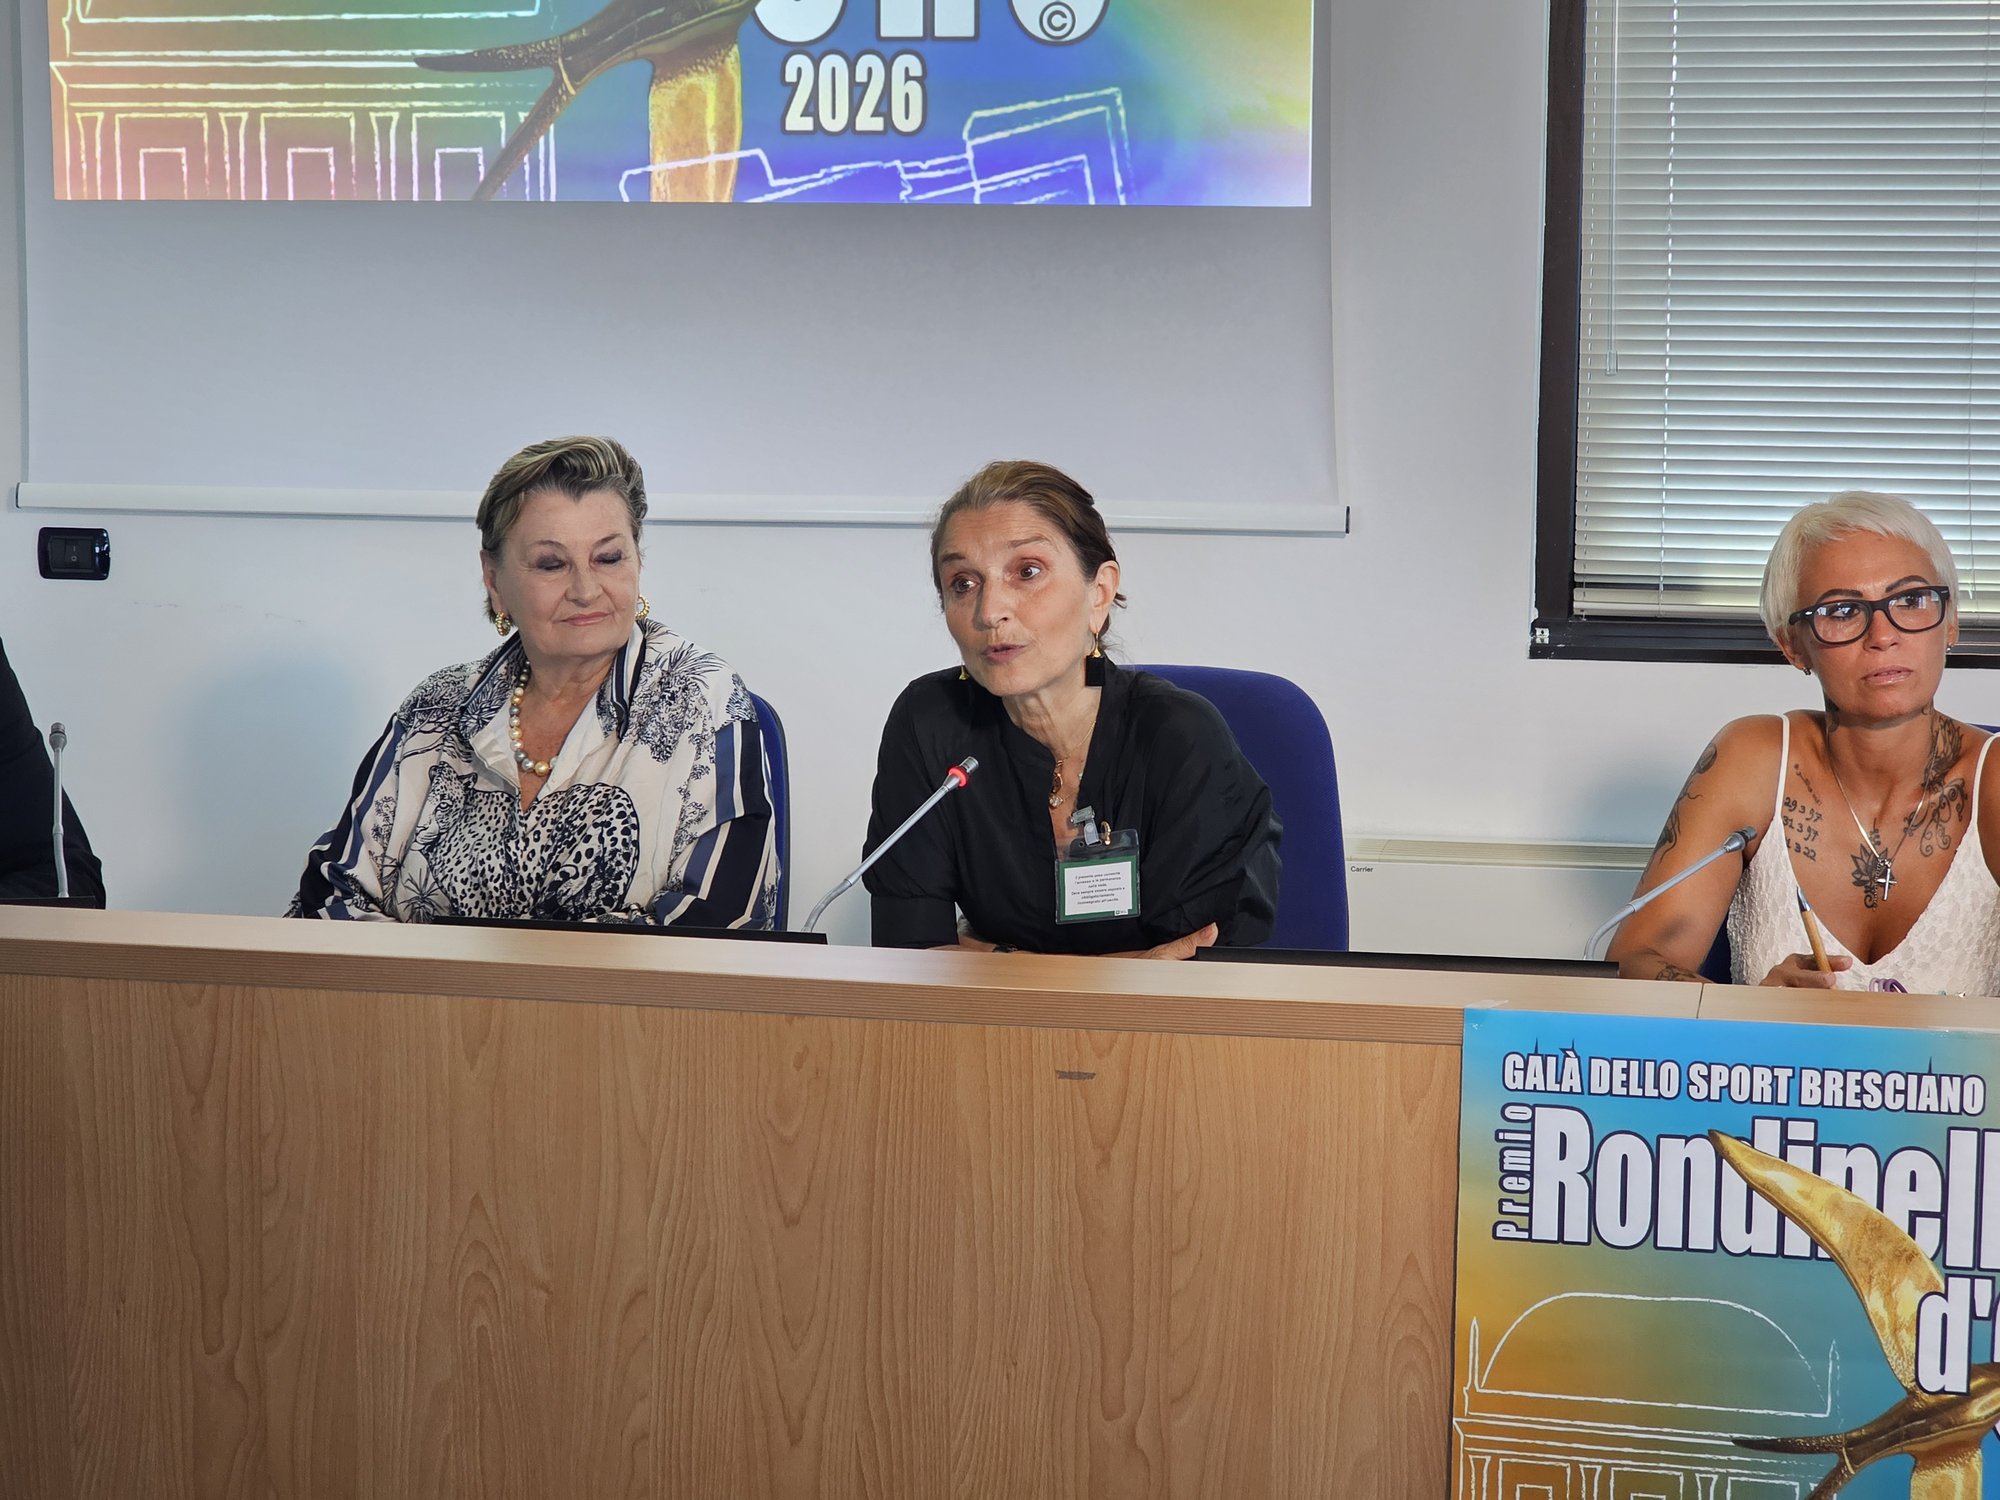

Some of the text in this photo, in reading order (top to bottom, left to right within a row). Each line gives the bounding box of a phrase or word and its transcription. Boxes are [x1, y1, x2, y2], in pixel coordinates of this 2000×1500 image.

[782, 51, 926, 134] 2026
[1784, 797, 1797, 812] 29
[1503, 1047, 1986, 1116] GALÀ DELLO SPORT BRESCIANO
[1494, 1104, 1532, 1239] Premio
[1916, 1274, 2000, 1396] d'
